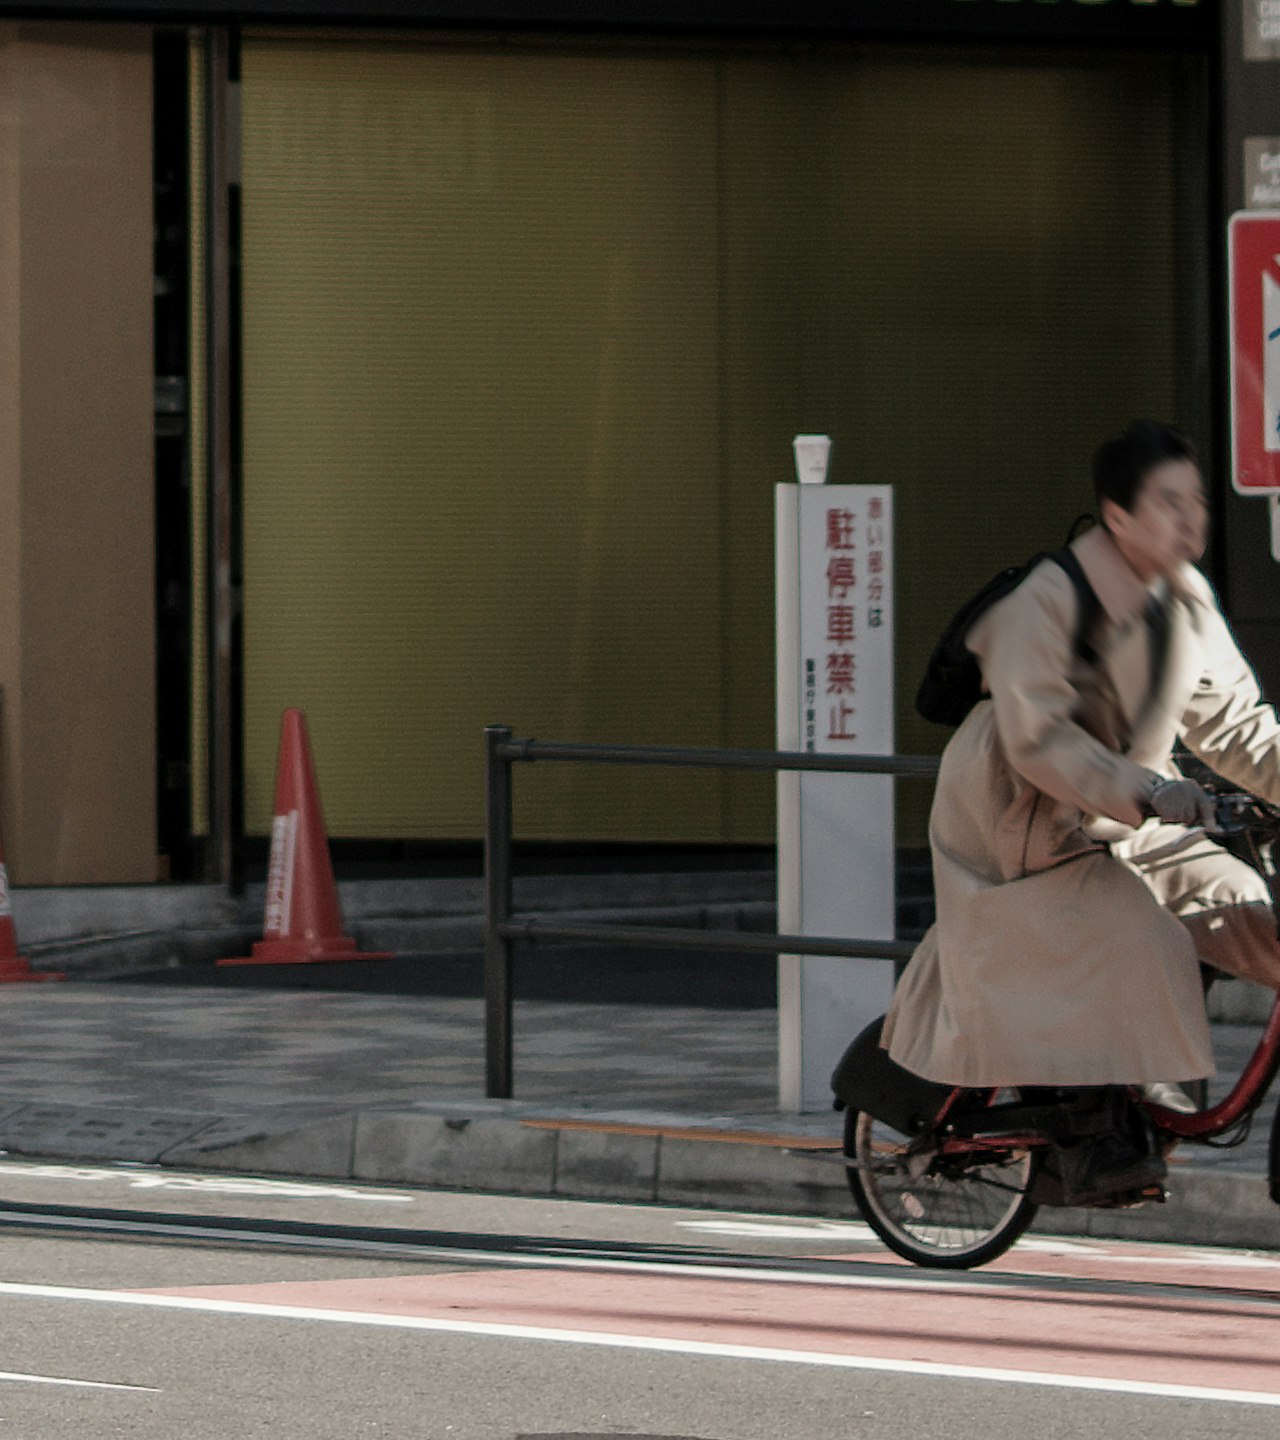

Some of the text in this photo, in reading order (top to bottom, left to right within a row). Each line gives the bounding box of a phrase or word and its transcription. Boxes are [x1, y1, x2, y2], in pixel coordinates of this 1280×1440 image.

[824, 507, 857, 742] 駐停車禁止
